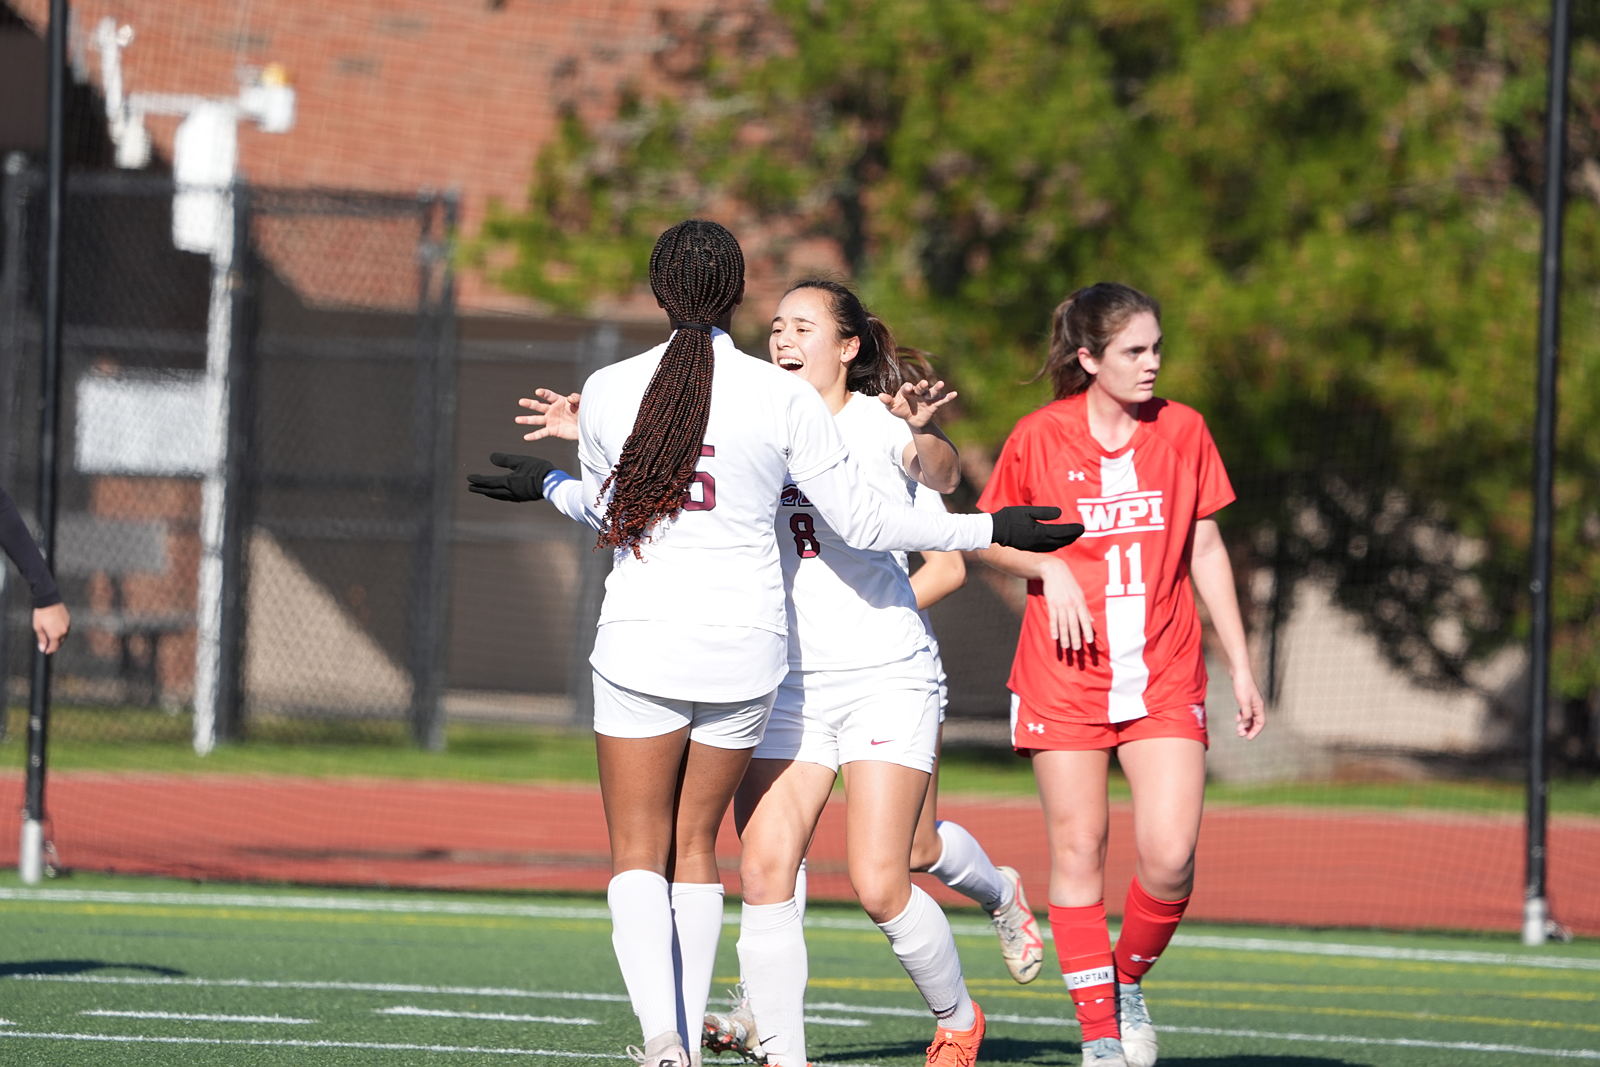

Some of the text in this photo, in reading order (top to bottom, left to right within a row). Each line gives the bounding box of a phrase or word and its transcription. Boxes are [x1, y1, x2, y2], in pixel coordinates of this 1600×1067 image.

[1077, 498, 1164, 531] WPI
[790, 513, 821, 559] 8
[1104, 542, 1146, 596] 11
[1072, 971, 1109, 985] CAPTAIN
